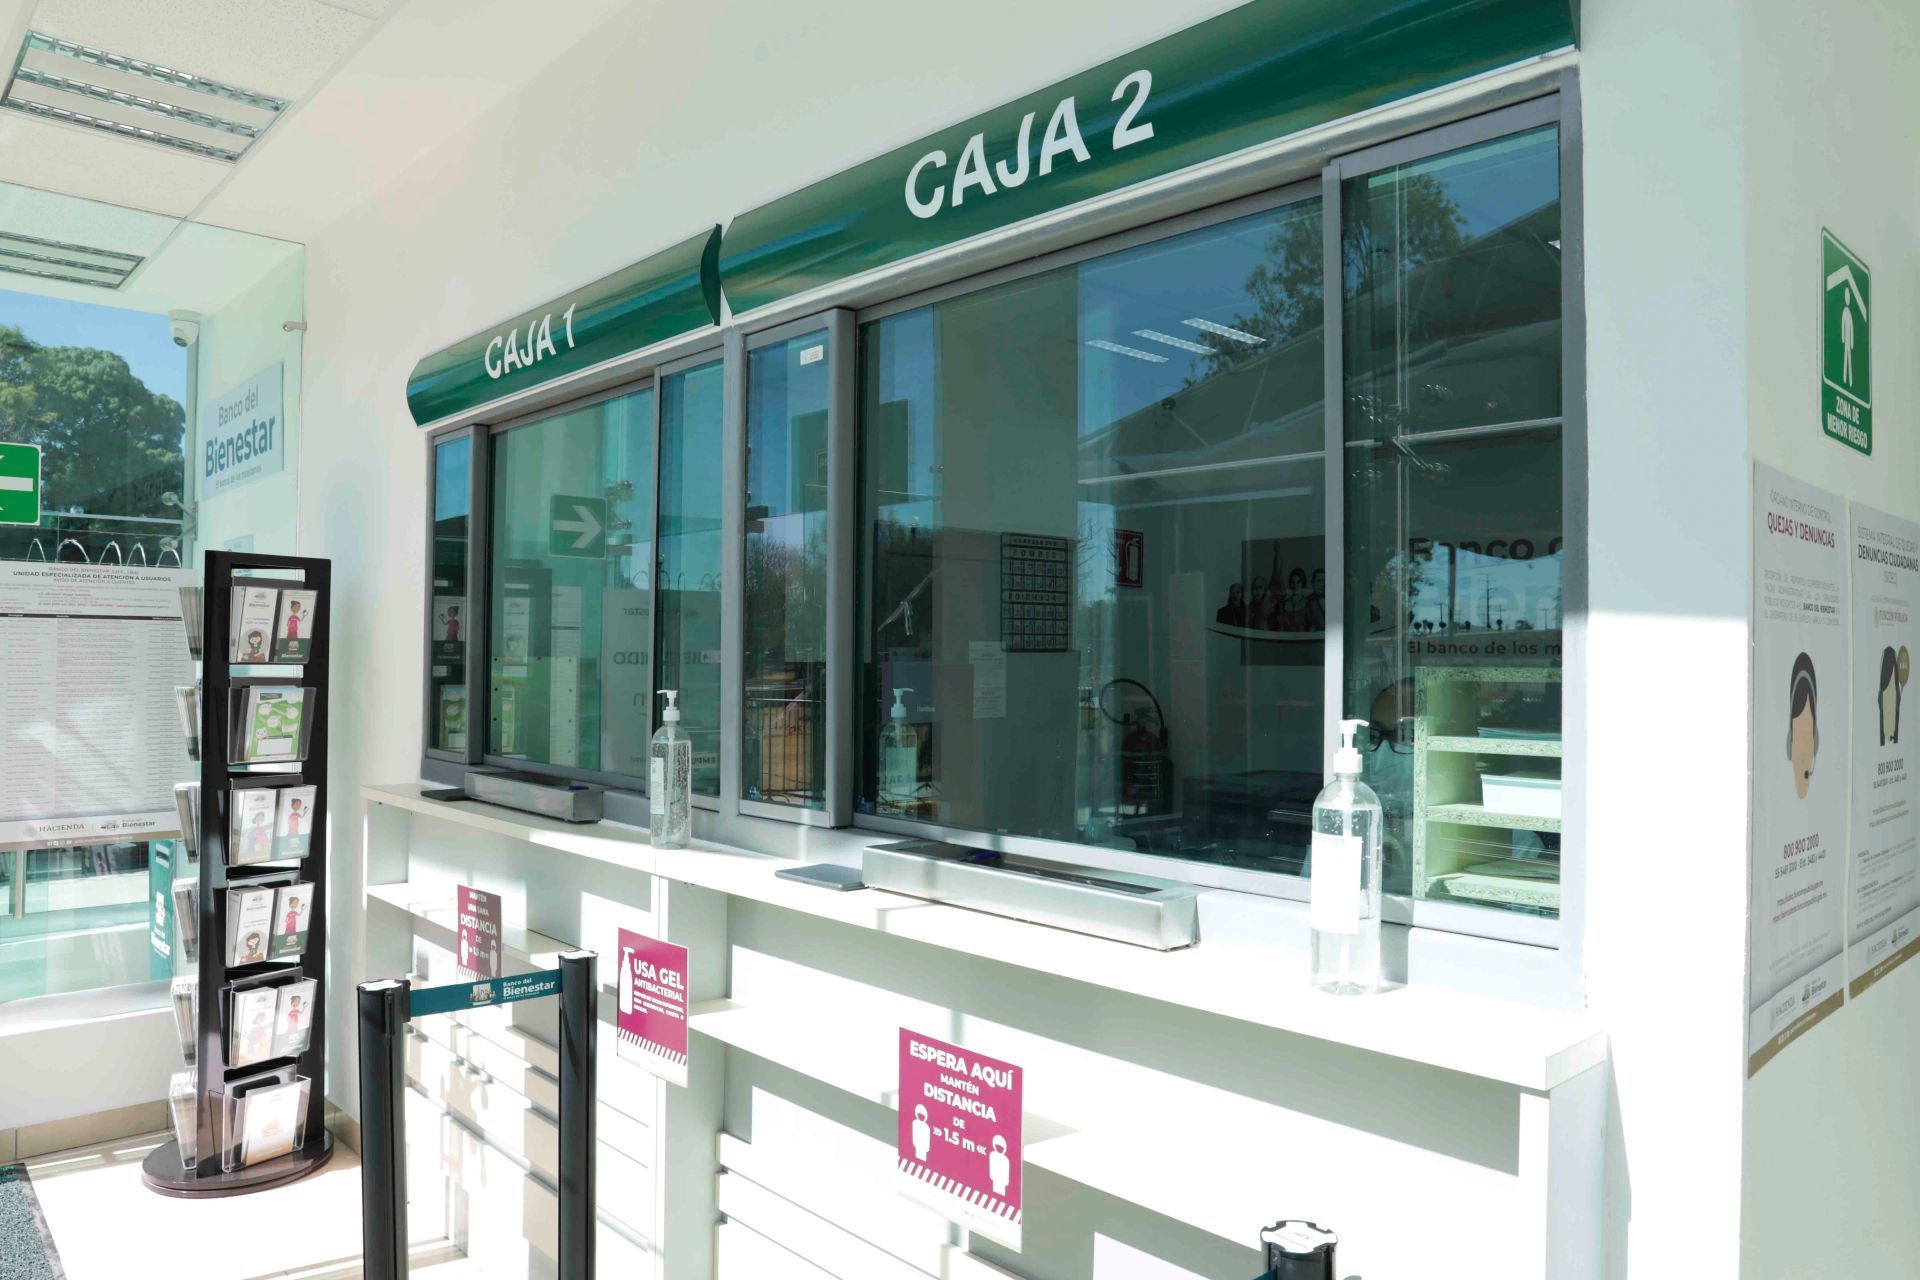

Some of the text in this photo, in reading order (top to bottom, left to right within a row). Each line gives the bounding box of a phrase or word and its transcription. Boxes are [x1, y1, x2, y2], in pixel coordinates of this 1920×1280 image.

[904, 68, 1156, 220] CAJA 2
[484, 302, 577, 380] CAJA 1
[218, 384, 259, 428] Banco del
[1835, 395, 1861, 425] ZONA DE
[1827, 412, 1868, 450] MENOR RIESGO
[205, 415, 276, 478] Bienestar
[1767, 511, 1836, 549] QUEJAS Y DENUNCIAS
[1857, 543, 1919, 572] DENUNCIAS CIUDADANAS
[41, 571, 91, 579] ESPECIALIZADA
[102, 573, 134, 581] ATENCIÓN
[140, 575, 172, 583] USUARIOS
[1428, 639, 1480, 655] banco
[1488, 639, 1507, 655] de
[1512, 639, 1539, 655] los
[39, 823, 86, 833] HACIENDA
[1783, 833, 1820, 859] 800 900 2000
[460, 912, 498, 937] DISTANCIA
[475, 934, 483, 944] DE
[502, 977, 533, 988] Banco del
[633, 957, 685, 991] USA GEL
[503, 980, 556, 998] Bienestar
[633, 976, 685, 1003] ANTIBACTERIAL
[909, 1039, 1014, 1092] ESPERA AQUÍ
[940, 1072, 980, 1097] MANTÉN
[923, 1081, 998, 1123] DISTANCIA
[952, 1115, 967, 1130] DE
[942, 1126, 976, 1153] 1.5 m
